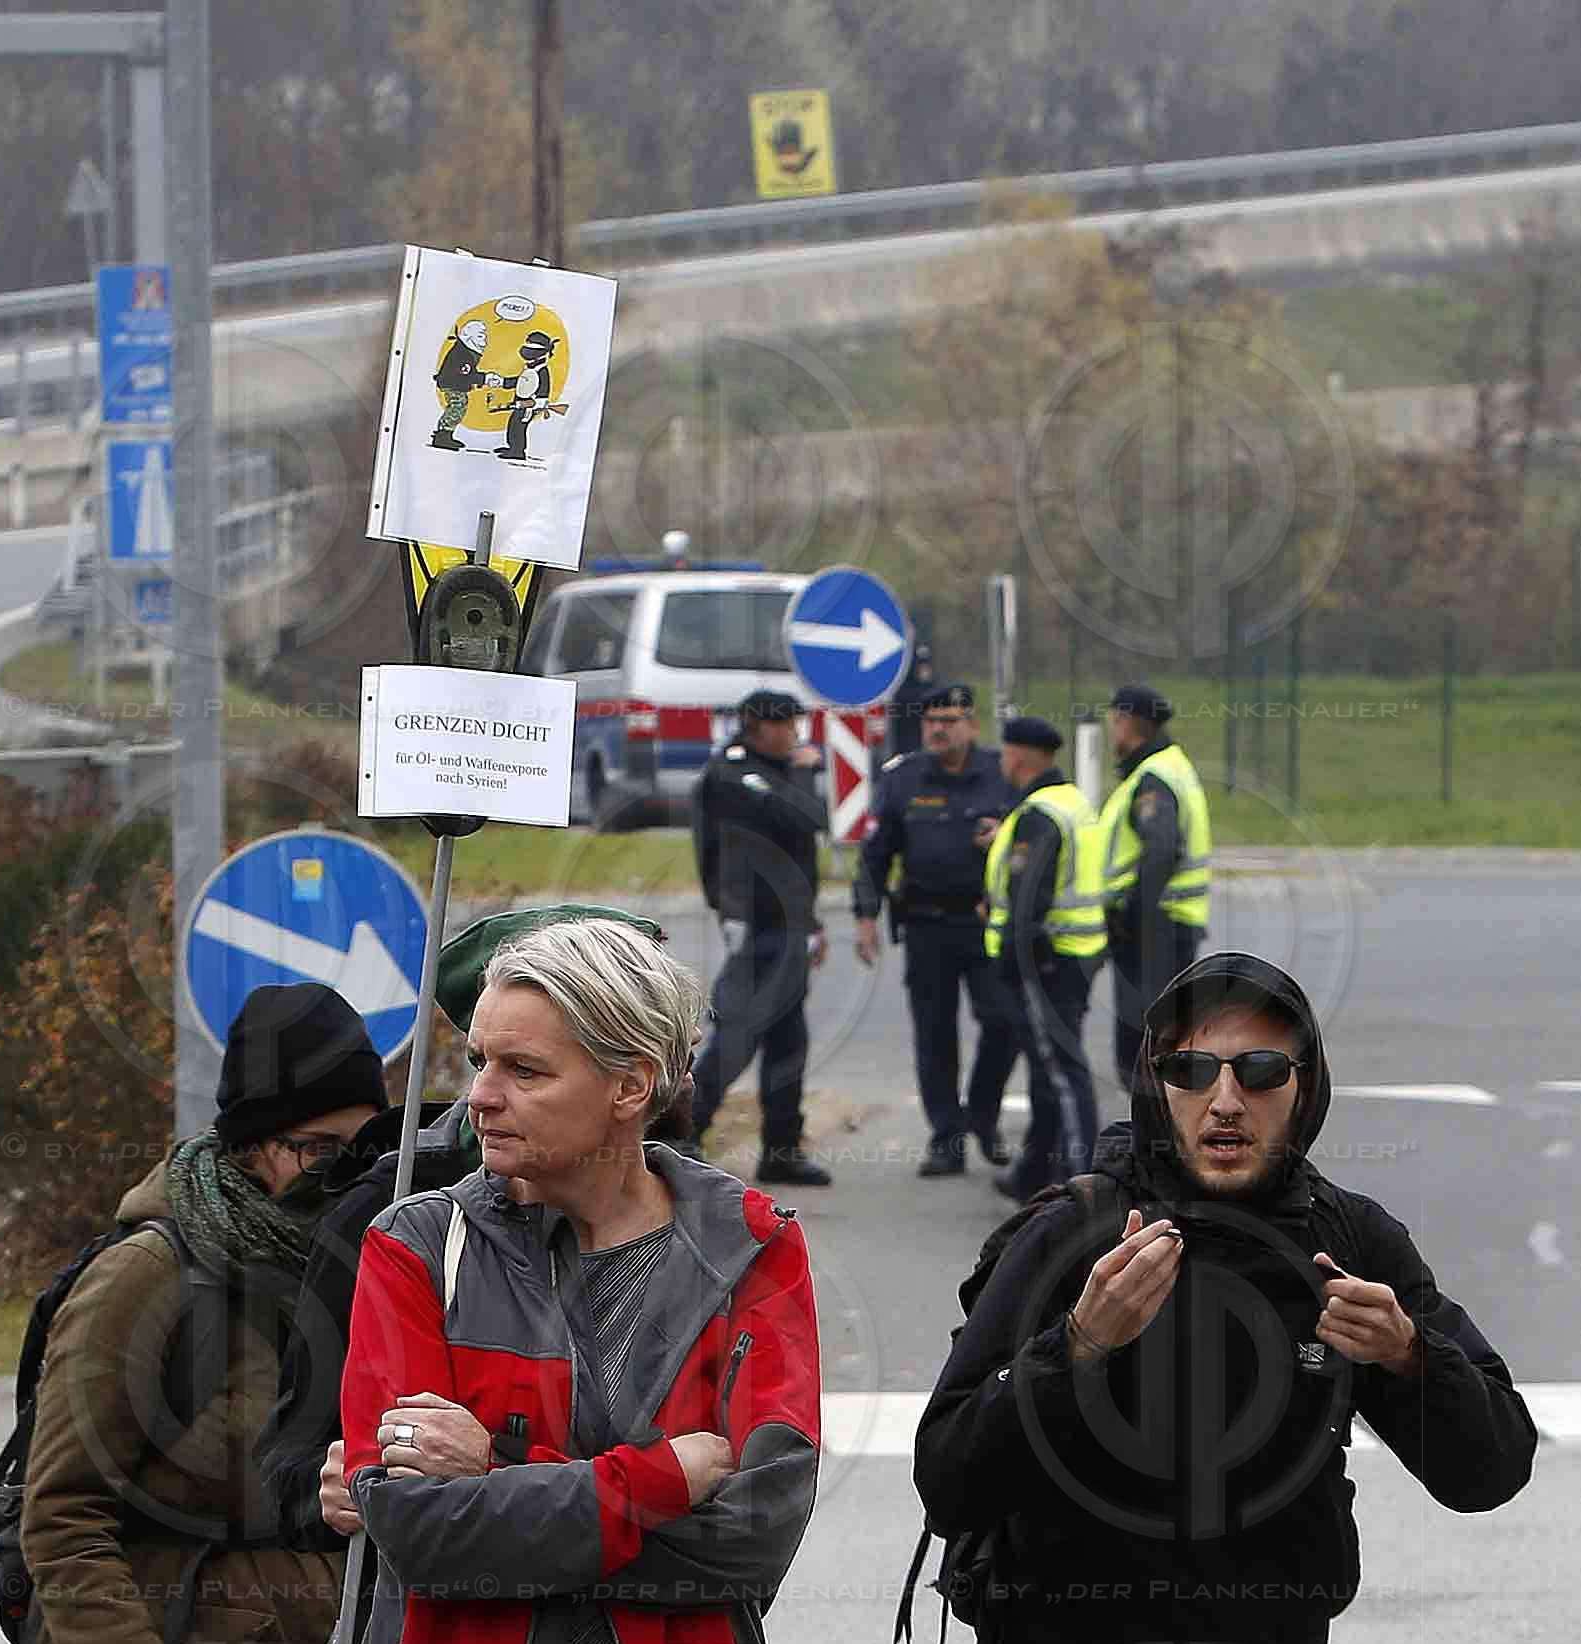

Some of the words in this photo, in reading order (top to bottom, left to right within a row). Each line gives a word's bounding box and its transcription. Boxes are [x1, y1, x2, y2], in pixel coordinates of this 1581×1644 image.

[394, 714, 487, 737] GRENZEN
[492, 721, 551, 743] DICHT
[395, 752, 413, 765] für
[440, 754, 462, 769] und
[465, 755, 548, 777] Waffenexporte
[435, 771, 463, 785] nach
[466, 774, 508, 790] Syrien!
